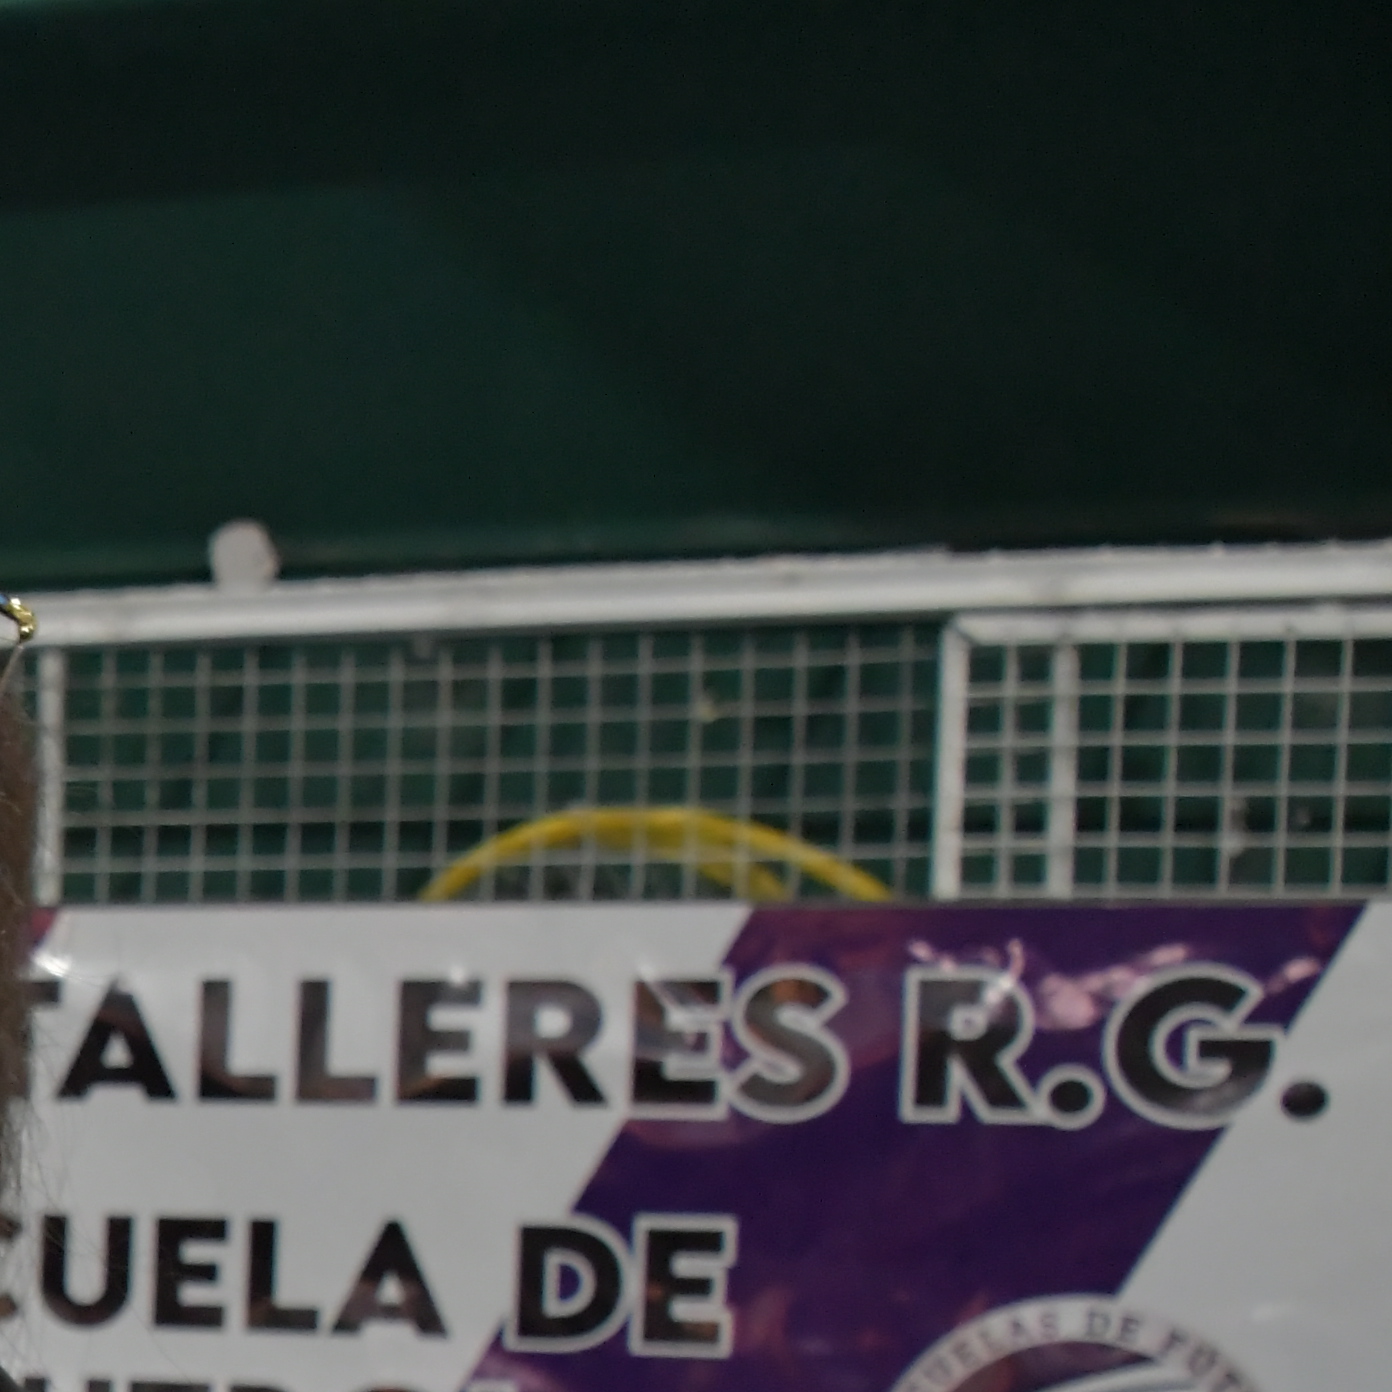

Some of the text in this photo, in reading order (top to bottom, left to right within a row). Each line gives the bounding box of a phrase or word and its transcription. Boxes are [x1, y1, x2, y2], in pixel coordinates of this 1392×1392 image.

[899, 962, 1330, 1130] R.G.
[12, 1214, 737, 1358] UELA DE
